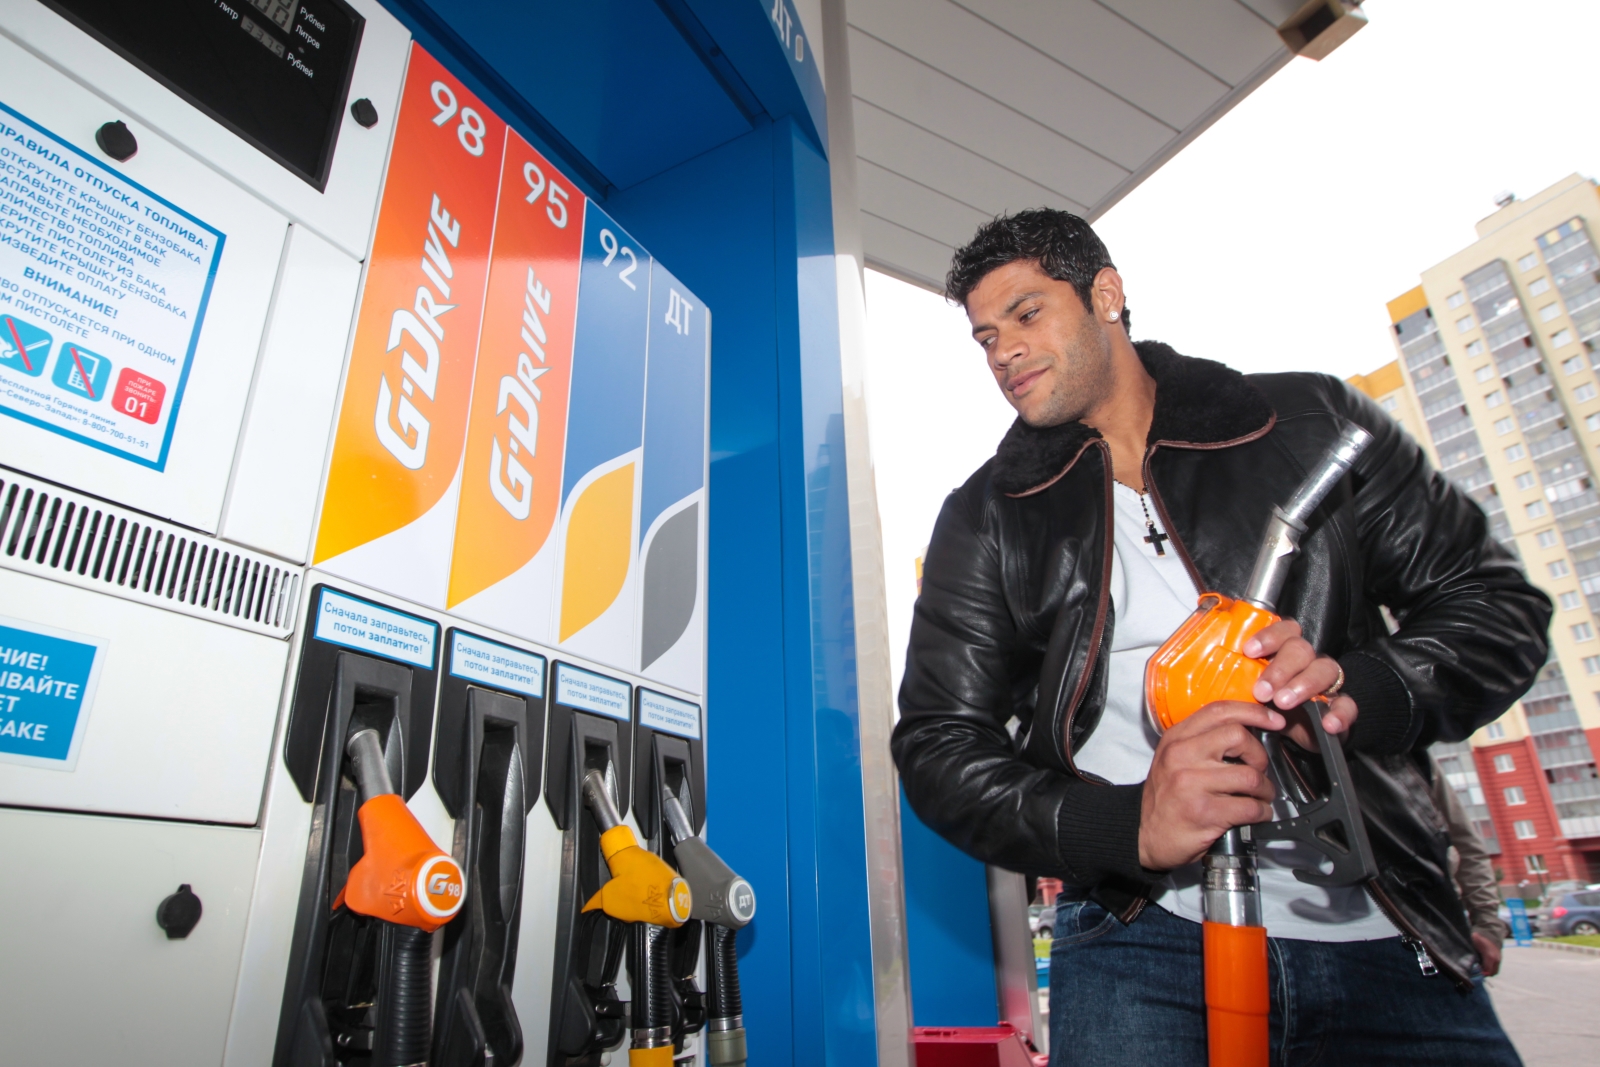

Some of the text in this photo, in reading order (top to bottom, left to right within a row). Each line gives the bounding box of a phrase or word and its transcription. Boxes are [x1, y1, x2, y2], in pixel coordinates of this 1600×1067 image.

[219, 2, 239, 20] литр
[300, 6, 326, 33] Рублей
[296, 24, 320, 49] Литров
[287, 52, 314, 78] Рублей
[430, 80, 487, 157] 98
[0, 147, 201, 265] ОТКРУТИТЕ КРЫШКУ БЕНЗОБАКА
[74, 167, 140, 212] ОТПУСКА
[144, 205, 208, 251] ТОПЛИВА:
[523, 162, 569, 229] 95
[0, 172, 161, 267] АПРАВЬТЕ НЕОБХОДИМОЕ
[66, 197, 132, 237] ПИСТОЛЕТ
[133, 233, 142, 244] В
[144, 239, 167, 258] БАК
[0, 203, 166, 296] ЕРИТЕ ПИСТОЛЕТ ИЗ БАКА
[79, 229, 135, 266] ТОПЛИВА
[600, 228, 638, 291] 92
[0, 231, 126, 299] ИЗВЕДИТЕ ОПЛАТУ
[23, 266, 118, 319] ВНИМАНИЕ!
[60, 249, 118, 282] КРЫШКУ
[119, 279, 187, 319] БЕНЗОБАКА
[0, 276, 176, 366] ВО ОТПУСКАЕТСЯ ПРИ ОДНОМ
[15, 299, 90, 339] ПИСТОЛЕТЕ
[665, 288, 693, 336] ДТ
[128, 380, 157, 397] ПОЖАРЕ
[137, 377, 152, 387] ПРИ
[53, 397, 89, 416] Горячей
[90, 413, 116, 427] линии
[124, 396, 148, 418] 01
[82, 418, 149, 449] 8-800-700-51-51
[325, 602, 430, 645] Сначала заправьтесь,
[333, 621, 423, 655] потом заплатите!
[457, 642, 540, 676] Сначала заправьтесь,
[464, 660, 534, 686] потом заплатите!
[560, 674, 588, 689] Сначала
[567, 689, 623, 710] потом заплатите!
[643, 698, 665, 712] Сначала
[648, 712, 664, 721] потом
[0, 717, 48, 742] АКЕ
[678, 892, 689, 909] 92
[739, 894, 751, 909] ДТ
